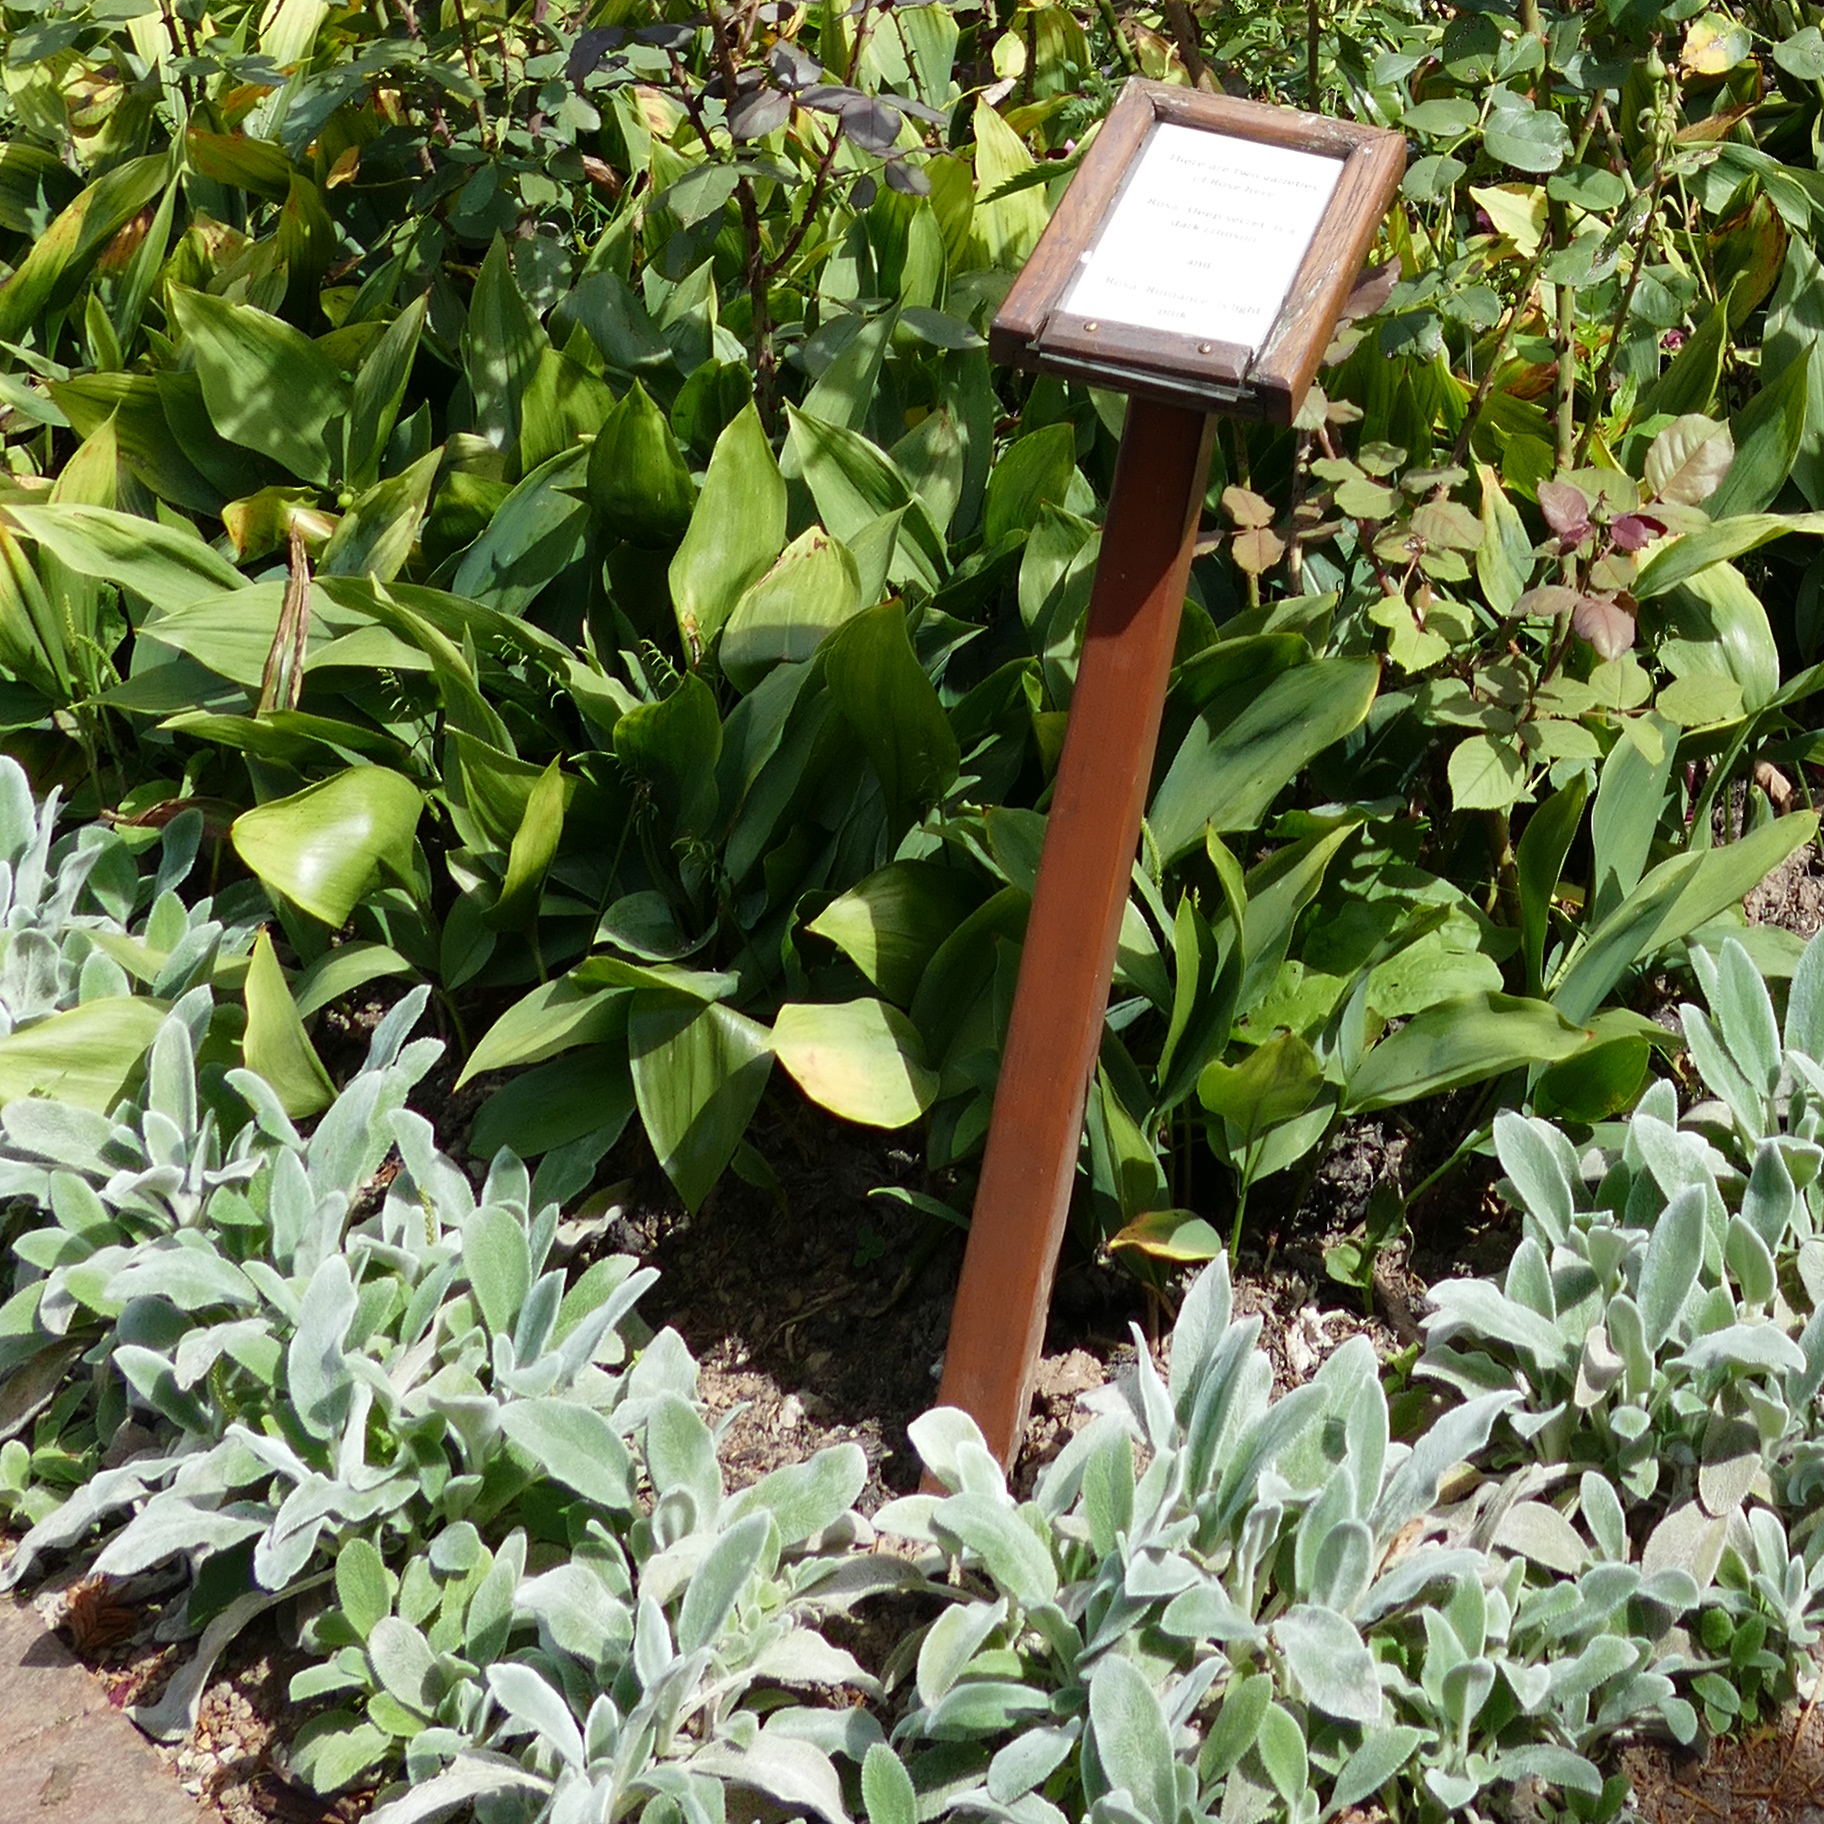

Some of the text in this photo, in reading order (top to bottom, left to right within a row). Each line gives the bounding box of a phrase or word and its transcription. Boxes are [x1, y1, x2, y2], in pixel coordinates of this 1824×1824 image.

[1169, 152, 1319, 191] There are two varieties
[1192, 175, 1275, 198] of Rose here
[1170, 219, 1200, 232] dark
[1185, 259, 1213, 270] and
[1157, 308, 1187, 320] pink
[1230, 302, 1262, 316] light
